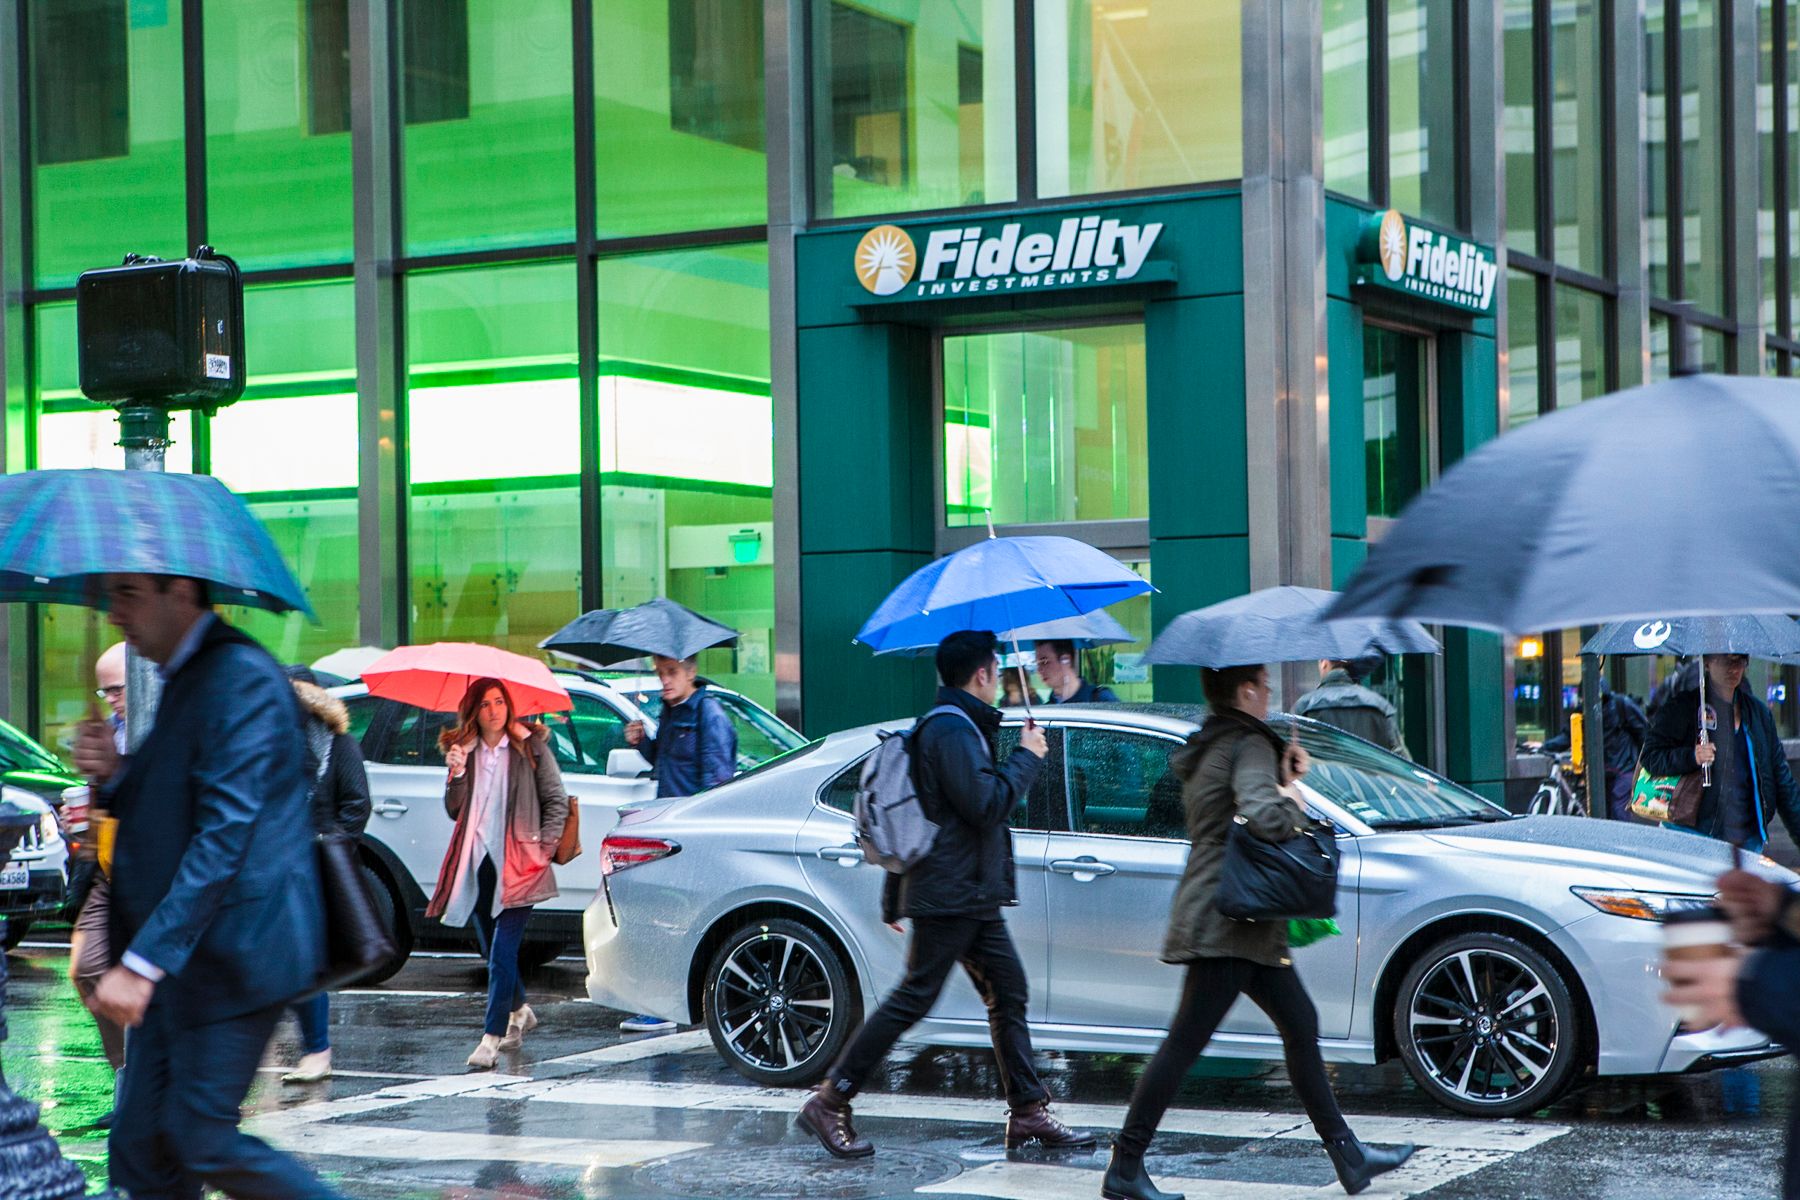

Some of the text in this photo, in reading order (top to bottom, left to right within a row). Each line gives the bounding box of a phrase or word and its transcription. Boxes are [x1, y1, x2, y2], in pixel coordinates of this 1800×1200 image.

[919, 216, 1163, 282] Fidelity
[1406, 225, 1497, 310] Fidelity
[917, 269, 1109, 296] INVESTMENTS
[1405, 277, 1479, 308] INVESTMENTS
